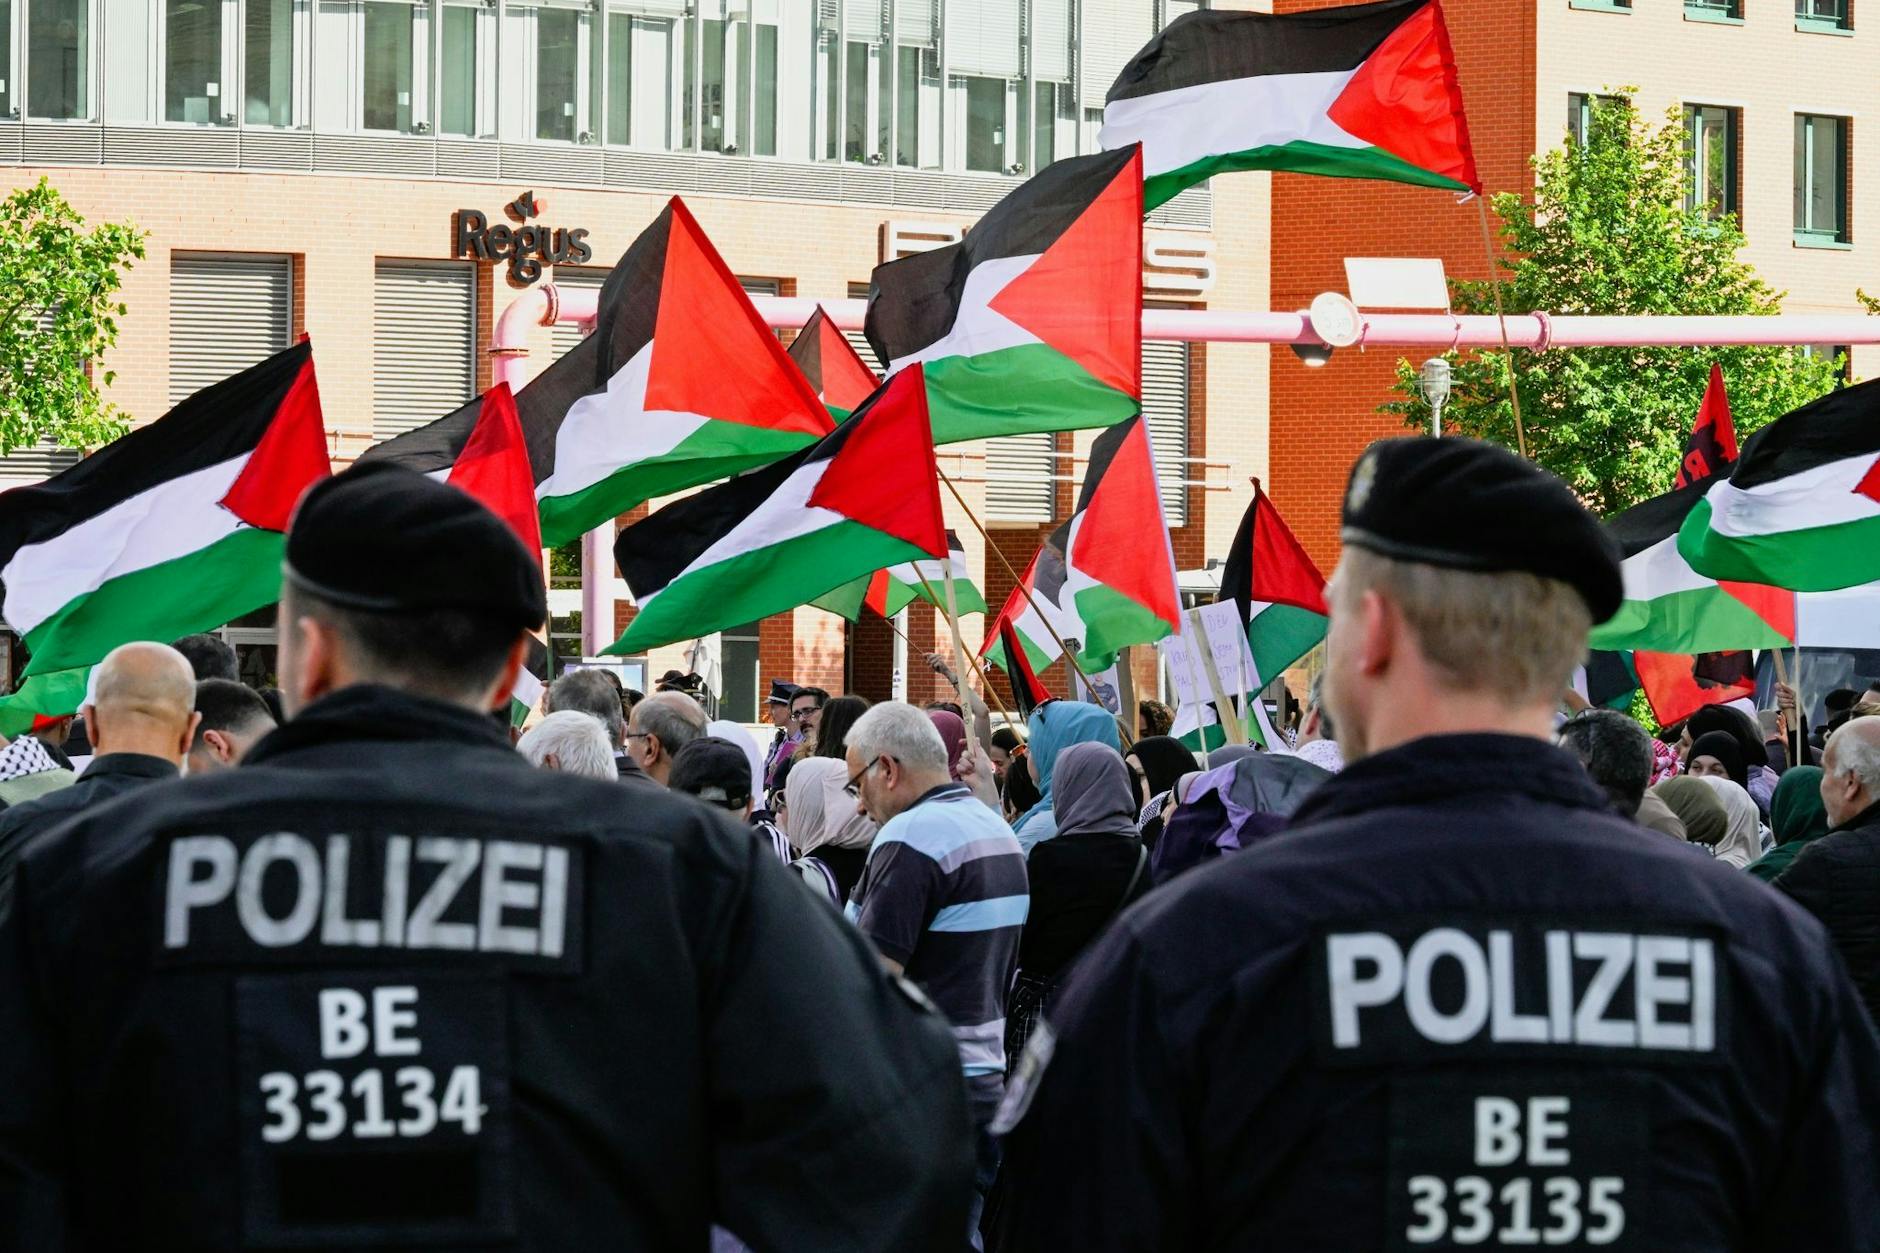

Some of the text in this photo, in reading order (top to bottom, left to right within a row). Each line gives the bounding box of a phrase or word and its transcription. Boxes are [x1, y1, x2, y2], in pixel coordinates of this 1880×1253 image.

[457, 208, 592, 284] Regus
[164, 831, 569, 959] POLIZEI
[319, 986, 421, 1059] BE
[1327, 927, 1716, 1051] POLIZEI
[259, 1065, 488, 1143] 33134
[1474, 1096, 1570, 1167] BE
[1406, 1175, 1626, 1244] 33135
